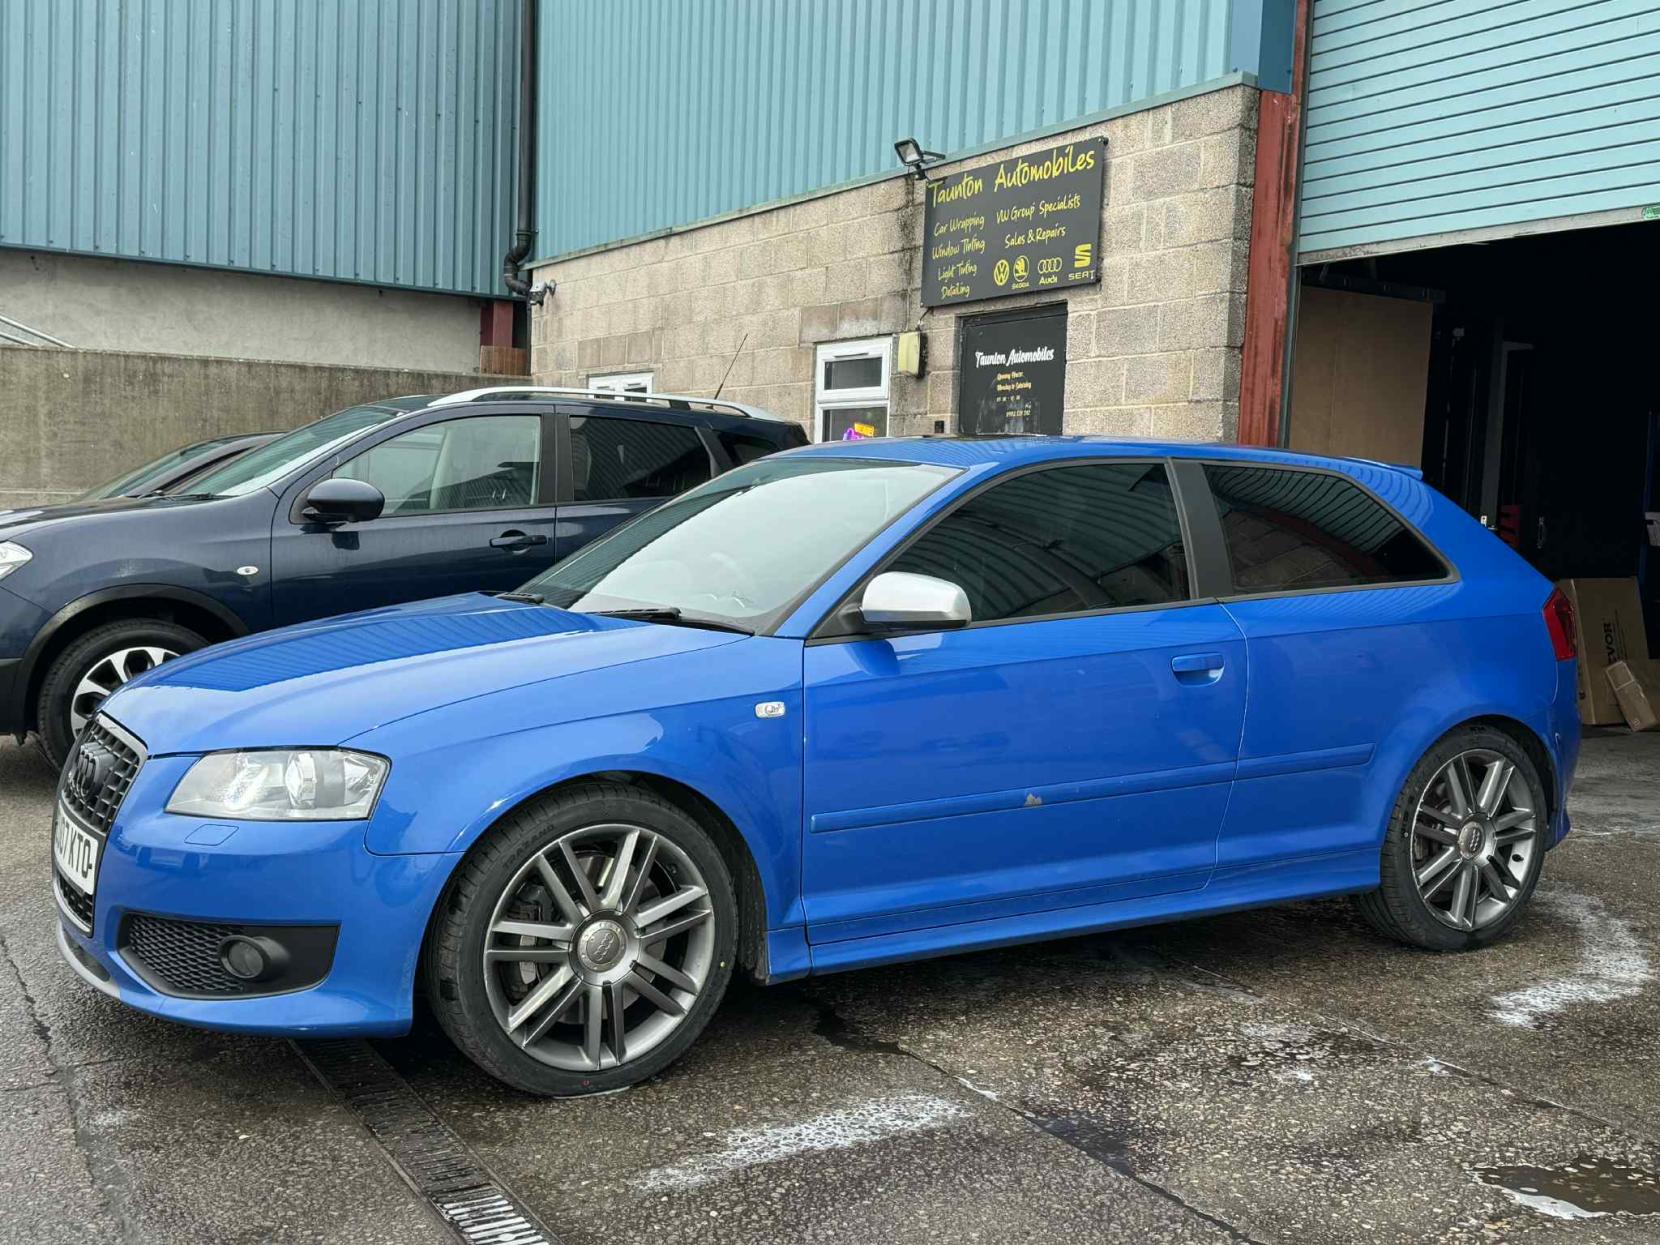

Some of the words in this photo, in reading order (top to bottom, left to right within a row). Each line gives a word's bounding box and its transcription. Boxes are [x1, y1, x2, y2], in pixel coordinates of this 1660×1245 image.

[928, 173, 983, 208] Taunton
[994, 145, 1095, 192] Automobiles
[996, 208, 1010, 224] VW
[1039, 193, 1081, 218] Specialists
[934, 221, 948, 236] Car
[949, 211, 985, 233] Wrapping
[1004, 231, 1025, 249] Sales
[1027, 229, 1036, 244] &
[1035, 222, 1066, 245] Repairs
[932, 240, 960, 260] Window
[960, 234, 986, 255] Tinting
[937, 264, 957, 283] Light
[956, 260, 977, 277] Tinting
[1038, 274, 1058, 285] Audi
[1068, 269, 1096, 281] SEAT
[975, 351, 1006, 368] Taunton
[1005, 346, 1055, 367] Automobiles
